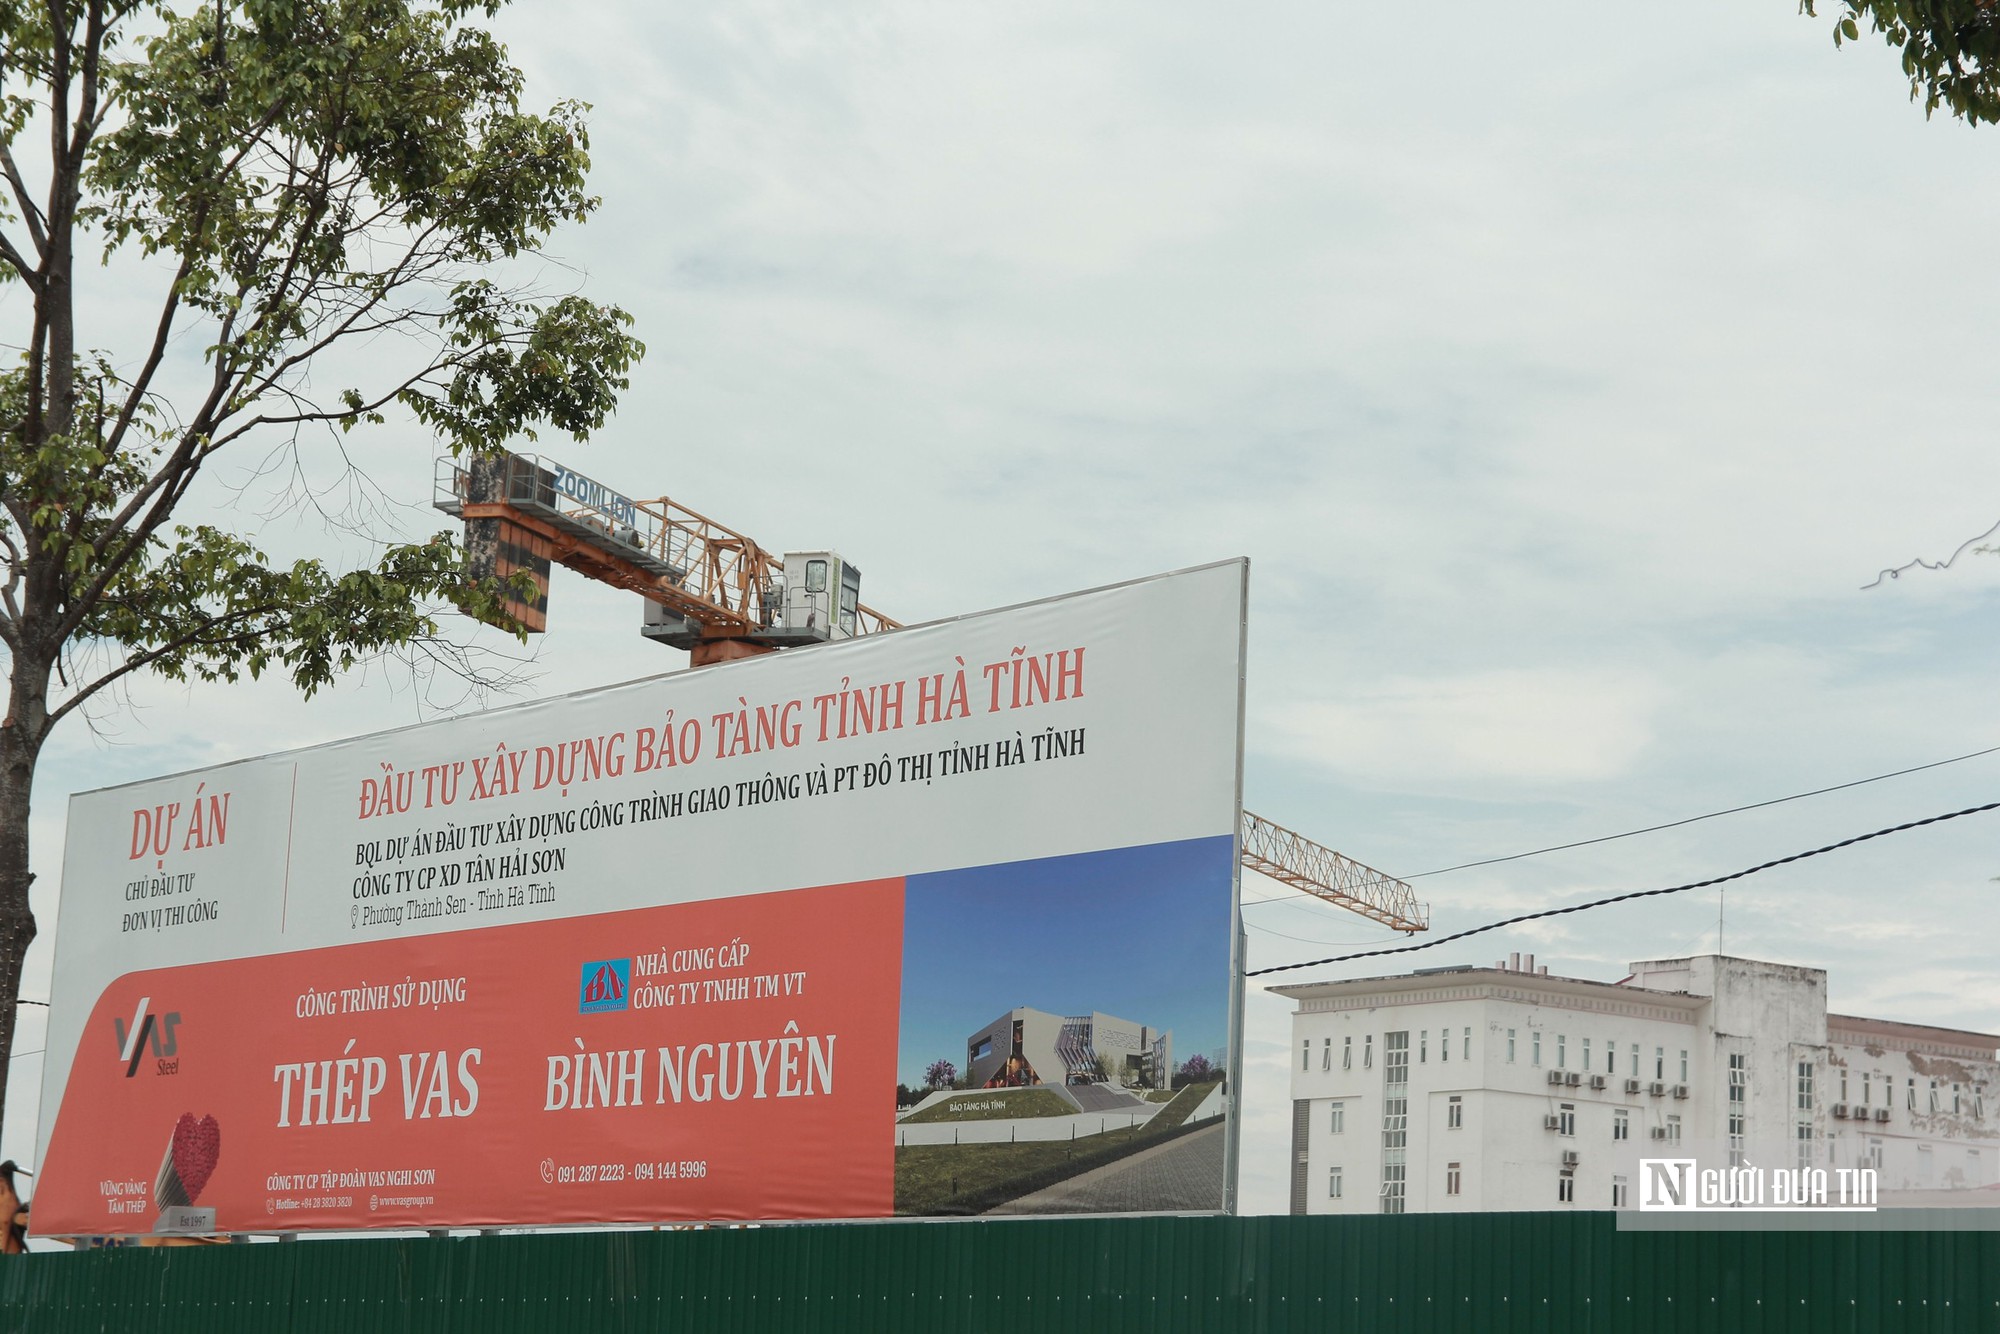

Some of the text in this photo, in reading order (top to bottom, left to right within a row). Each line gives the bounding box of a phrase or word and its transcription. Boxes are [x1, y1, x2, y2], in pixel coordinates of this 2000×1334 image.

[553, 463, 636, 529] ZOOMLION
[358, 645, 1086, 819] ĐẦU TƯ XÂY DỰNG BẢO TÀNG TỈNH HÀ TĨNH
[355, 726, 1086, 869] BQL DỰ ÁN ĐẦU TƯ XÂY DỰNG CÔNG TRÌNH GIAO THÔNG VÀ PT ĐÔ THỊ TỈNH HÀ TĨNH
[129, 782, 231, 869] DỰ ÁN
[125, 872, 195, 901] CHỦ ĐẦU TƯ
[353, 848, 566, 899] CÔNG TY CP XD TÂN HẢI SƠN
[122, 898, 218, 932] ĐƠN VỊ THI CÔNG
[362, 903, 404, 926] Phường
[407, 897, 442, 920] Thành
[445, 895, 466, 915] Sen
[478, 888, 504, 911] Tỉnh
[507, 886, 524, 907] Hà
[528, 882, 555, 905] Tĩnh
[636, 937, 750, 976] NHÀ CUNG CẤP
[296, 975, 467, 1018] CÔNG TRÌNH SỬ DỤNG
[633, 972, 806, 1009] CÔNG TY TNHH TM VT
[114, 997, 182, 1078] VAS
[156, 1059, 179, 1076] Steel
[274, 1038, 481, 1127] THÉP VAS
[544, 1020, 836, 1111] BÌNH NGUYÊN
[267, 1168, 435, 1192] CÔNG TY CP TẬP ĐOÀN VAS NGHI SƠN
[558, 1166, 575, 1183] 091
[578, 1165, 597, 1182] 287
[600, 1164, 625, 1181] 2223
[634, 1163, 654, 1180] 094
[657, 1162, 676, 1179] 144
[679, 1161, 707, 1178] 5996
[190, 1216, 206, 1227] 1997
[275, 1196, 352, 1210] Hotline: +84 28 3820 3820
[379, 1196, 434, 1209] www.vasgroup.vn
